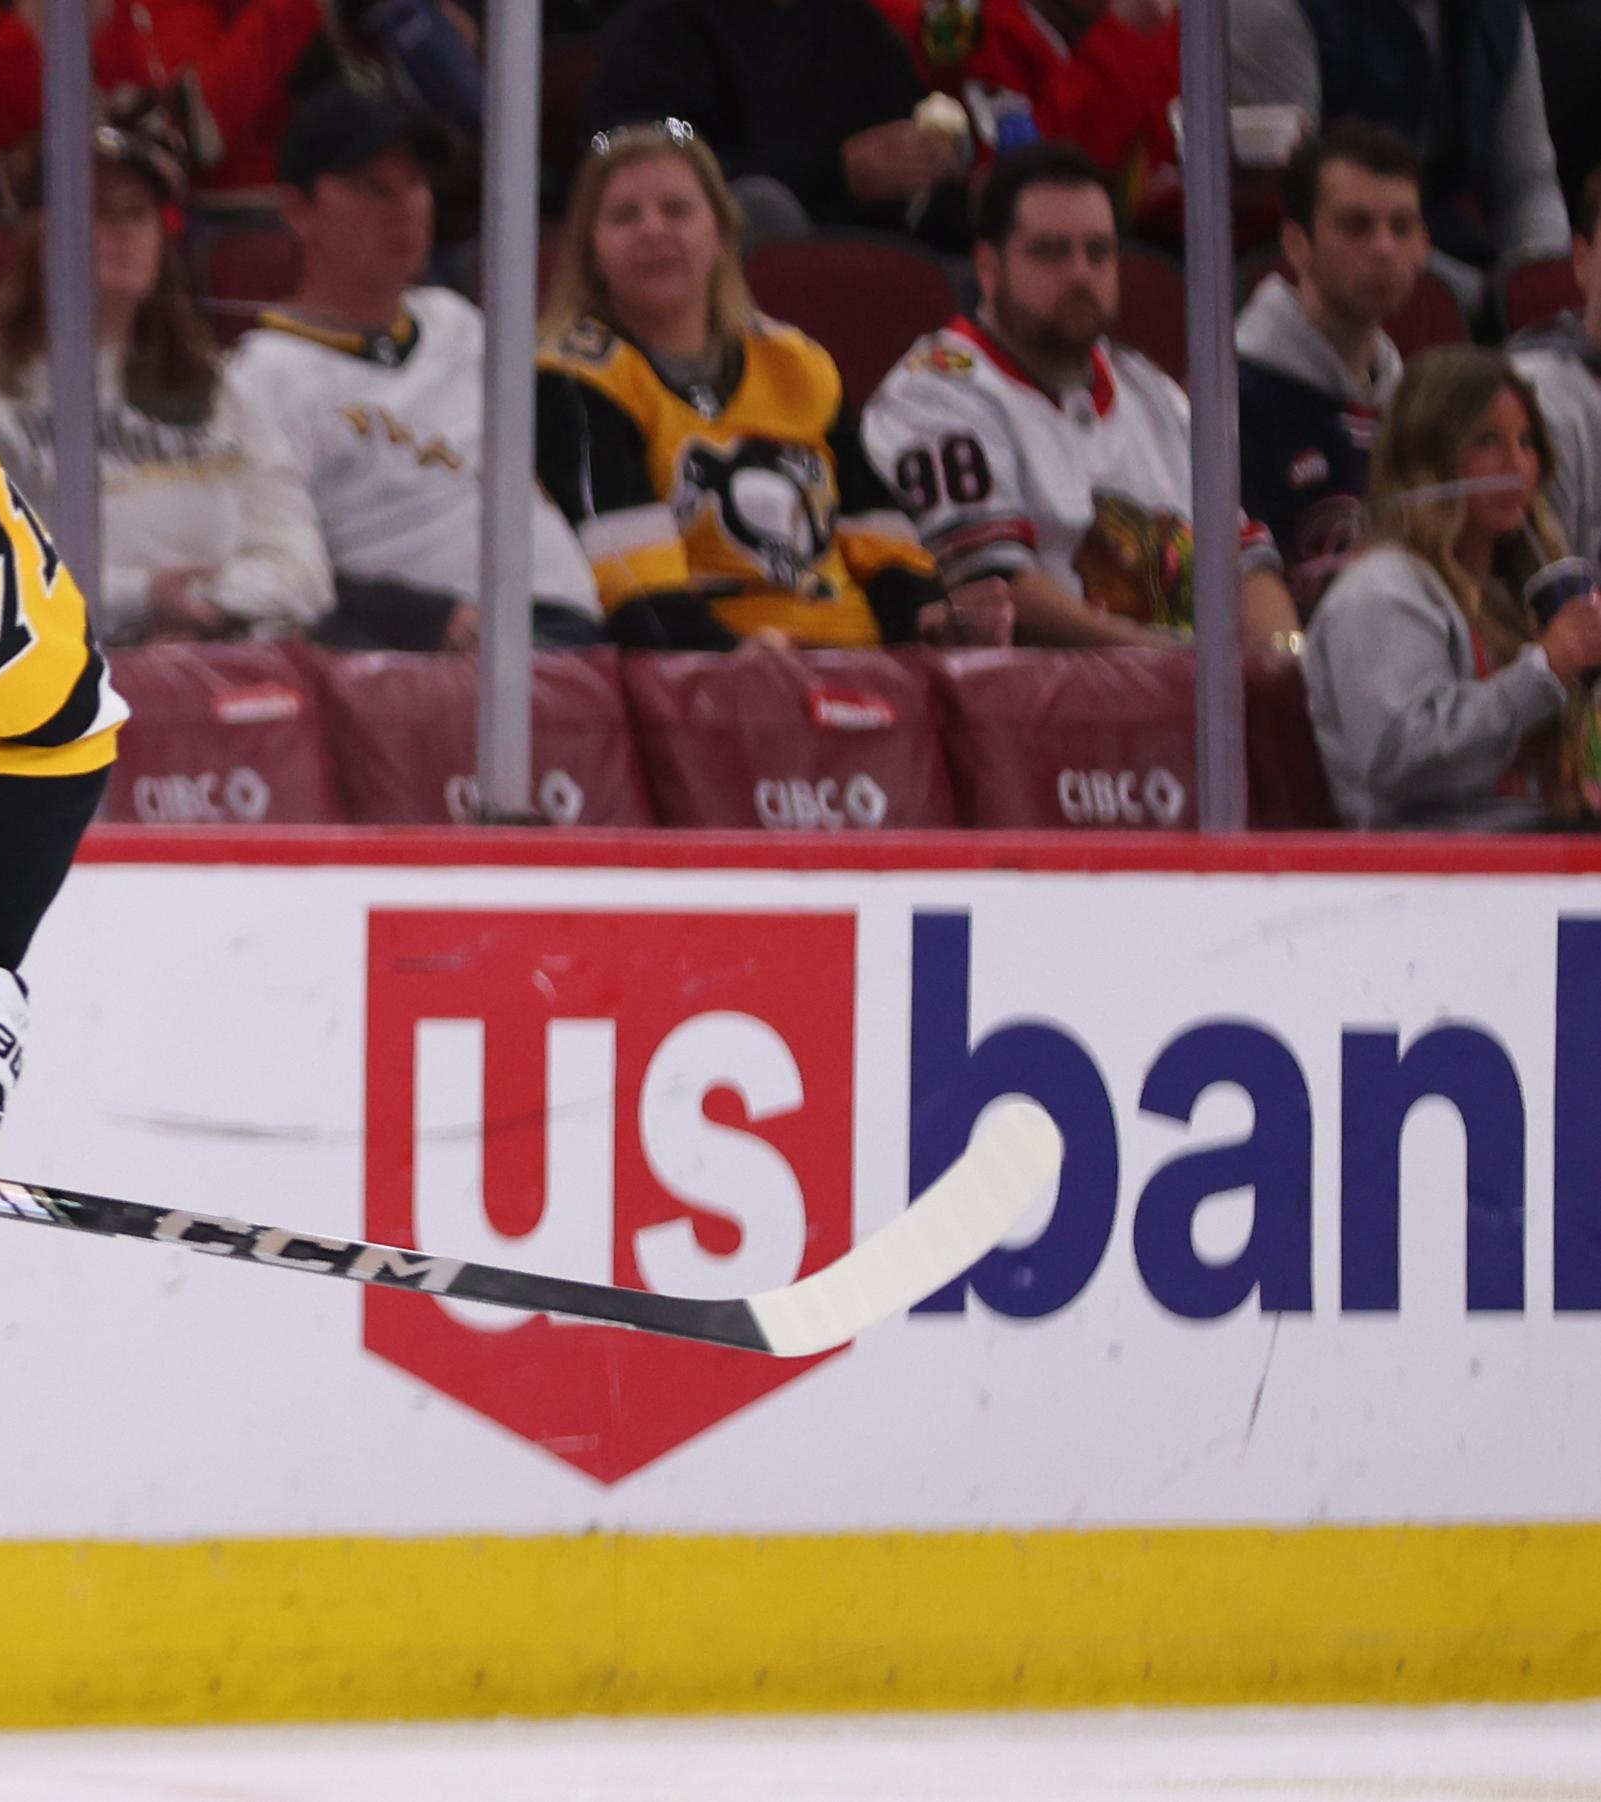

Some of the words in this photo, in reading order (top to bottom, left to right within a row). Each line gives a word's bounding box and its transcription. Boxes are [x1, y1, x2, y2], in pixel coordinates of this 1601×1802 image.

[896, 430, 993, 515] 98
[755, 778, 843, 829] CIBC
[1057, 768, 1142, 823] CIBC
[413, 1010, 806, 1332] us
[152, 1208, 468, 1293] CCM
